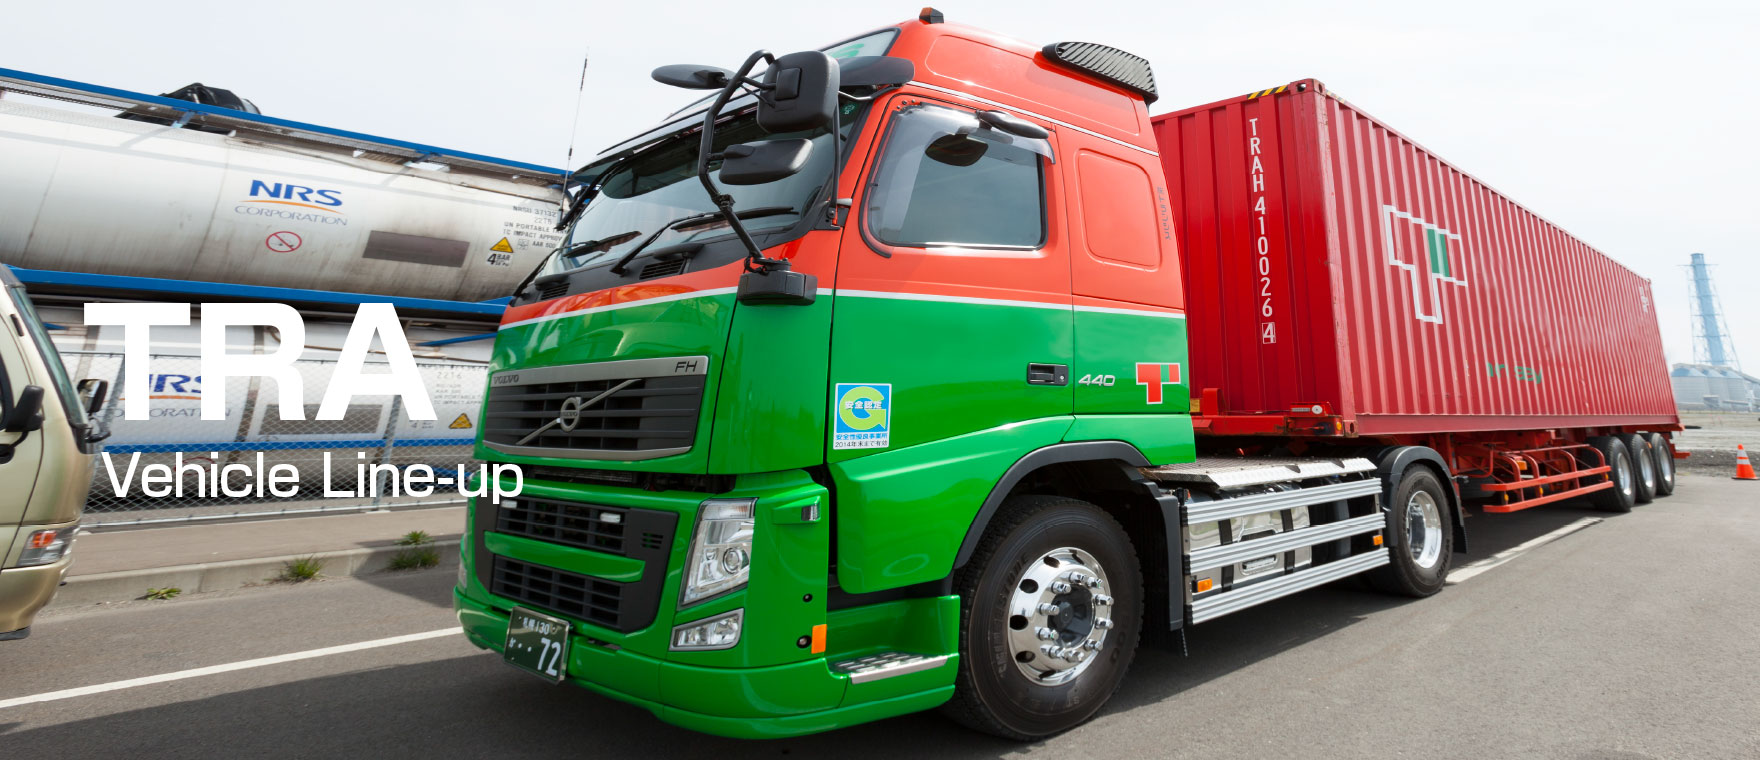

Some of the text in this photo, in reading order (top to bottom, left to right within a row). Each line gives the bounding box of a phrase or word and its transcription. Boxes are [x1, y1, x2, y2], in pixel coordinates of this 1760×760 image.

[249, 180, 343, 207] NRS
[234, 205, 348, 226] CORPORATION
[516, 223, 550, 232] PORTABLE
[513, 231, 537, 239] IMPACT
[675, 361, 698, 373] FH
[493, 374, 520, 385] VOLVO
[1078, 374, 1116, 387] 440
[845, 400, 882, 410] 安全認定
